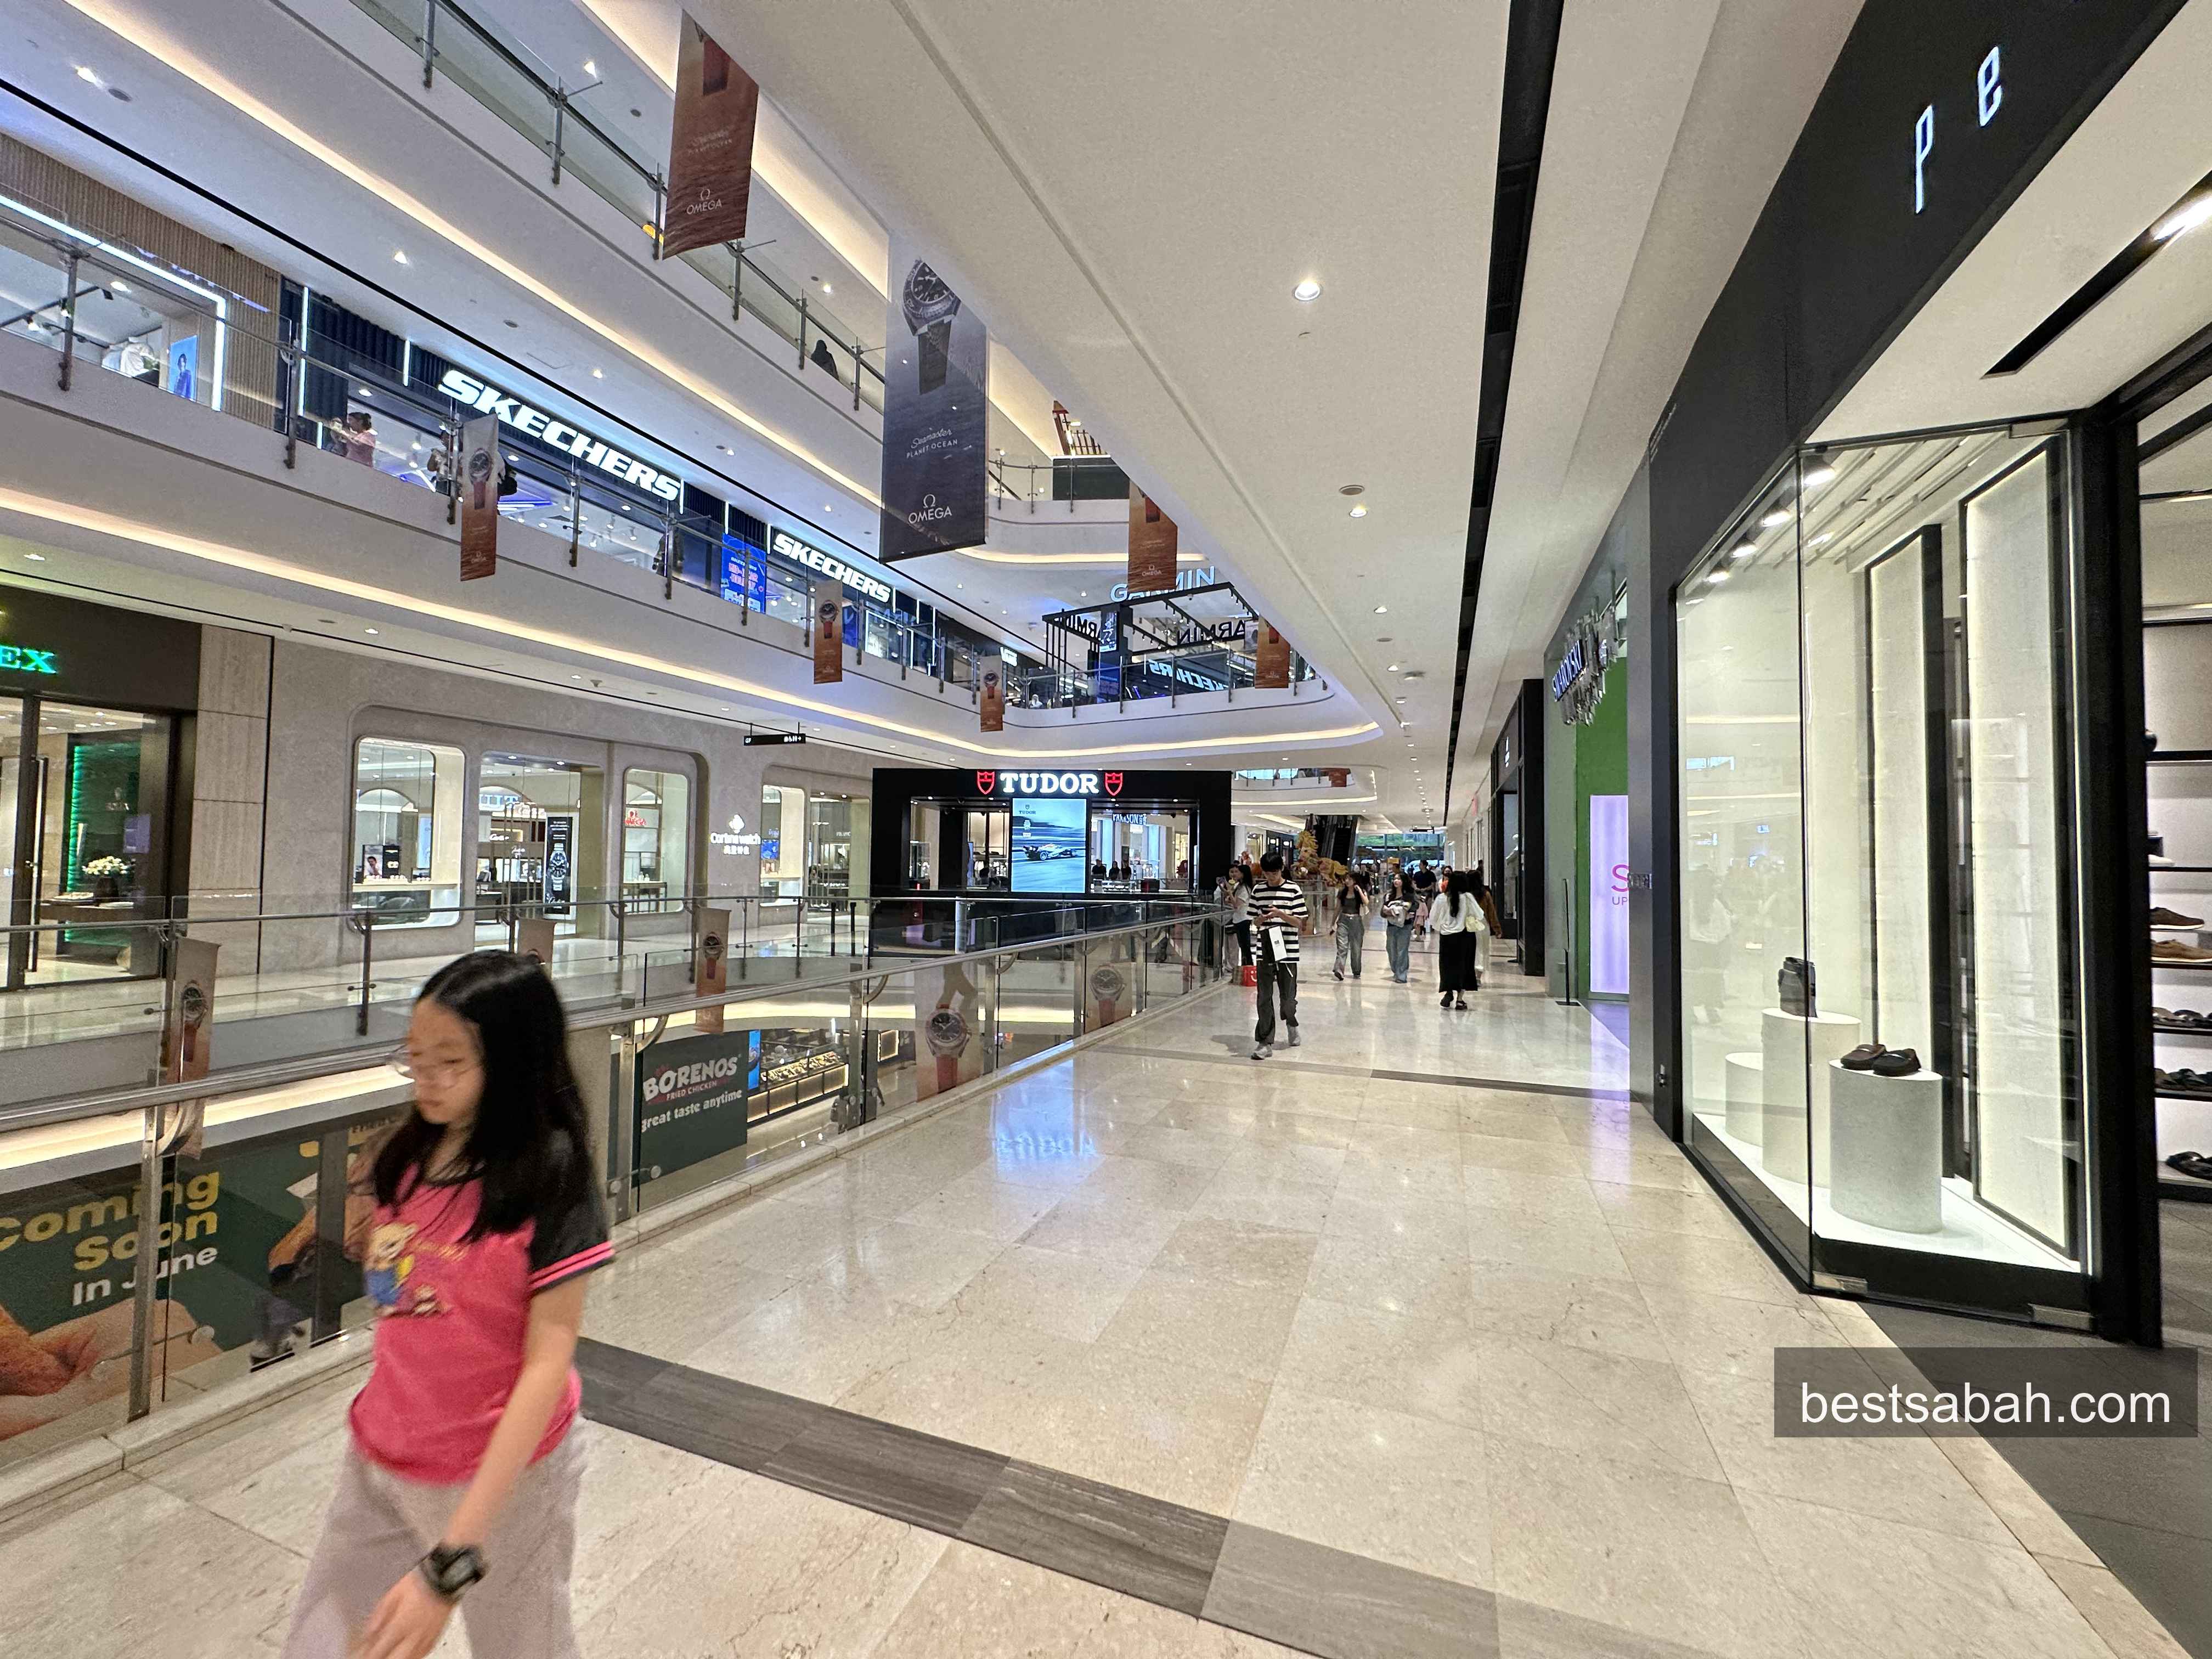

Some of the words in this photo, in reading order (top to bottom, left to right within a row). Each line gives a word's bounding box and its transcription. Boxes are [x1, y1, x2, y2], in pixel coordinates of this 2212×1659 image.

[686, 199, 723, 215] OMEGA
[438, 370, 681, 501] SKECHERS
[911, 428, 952, 449] Seamaster
[906, 445, 929, 459] PLANET
[931, 438, 958, 449] OCEAN
[908, 506, 952, 524] OMEGA
[772, 533, 891, 603] SKECHERS
[1000, 773, 1099, 794] TUDOR
[1612, 896, 1628, 905] UP
[643, 1057, 738, 1102] BORENOS
[666, 1087, 686, 1101] FRIED
[687, 1080, 718, 1095] CHICKEN
[674, 1102, 701, 1119] taste
[703, 1089, 743, 1110] anytime
[72, 1279, 111, 1307] In
